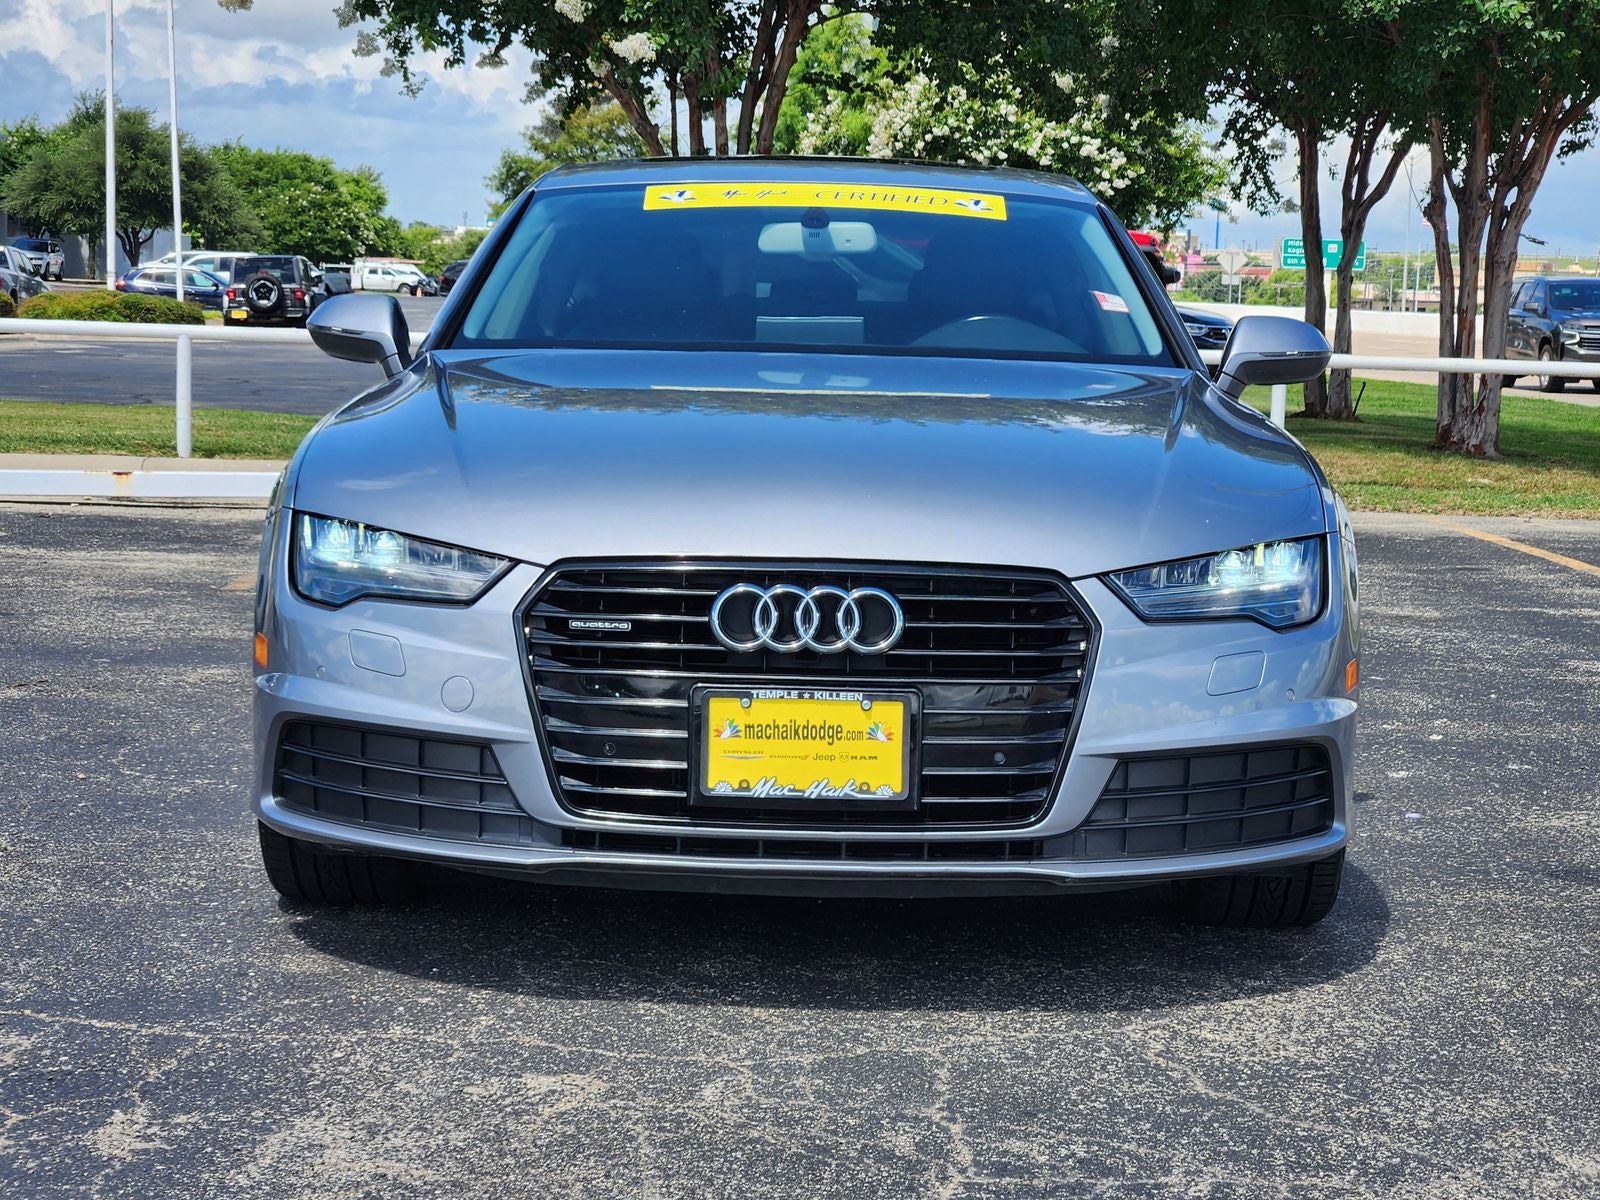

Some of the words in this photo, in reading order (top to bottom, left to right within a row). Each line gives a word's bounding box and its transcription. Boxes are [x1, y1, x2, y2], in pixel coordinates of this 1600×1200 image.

[815, 191, 948, 205] CERTIFIED
[571, 621, 628, 629] quattro
[751, 690, 798, 699] TEMPLE
[814, 691, 863, 701] KILLEEN
[744, 718, 864, 746] machaikdodge.com
[812, 752, 836, 763] Jeep
[751, 776, 803, 799] Mac
[803, 778, 859, 799] Haik
